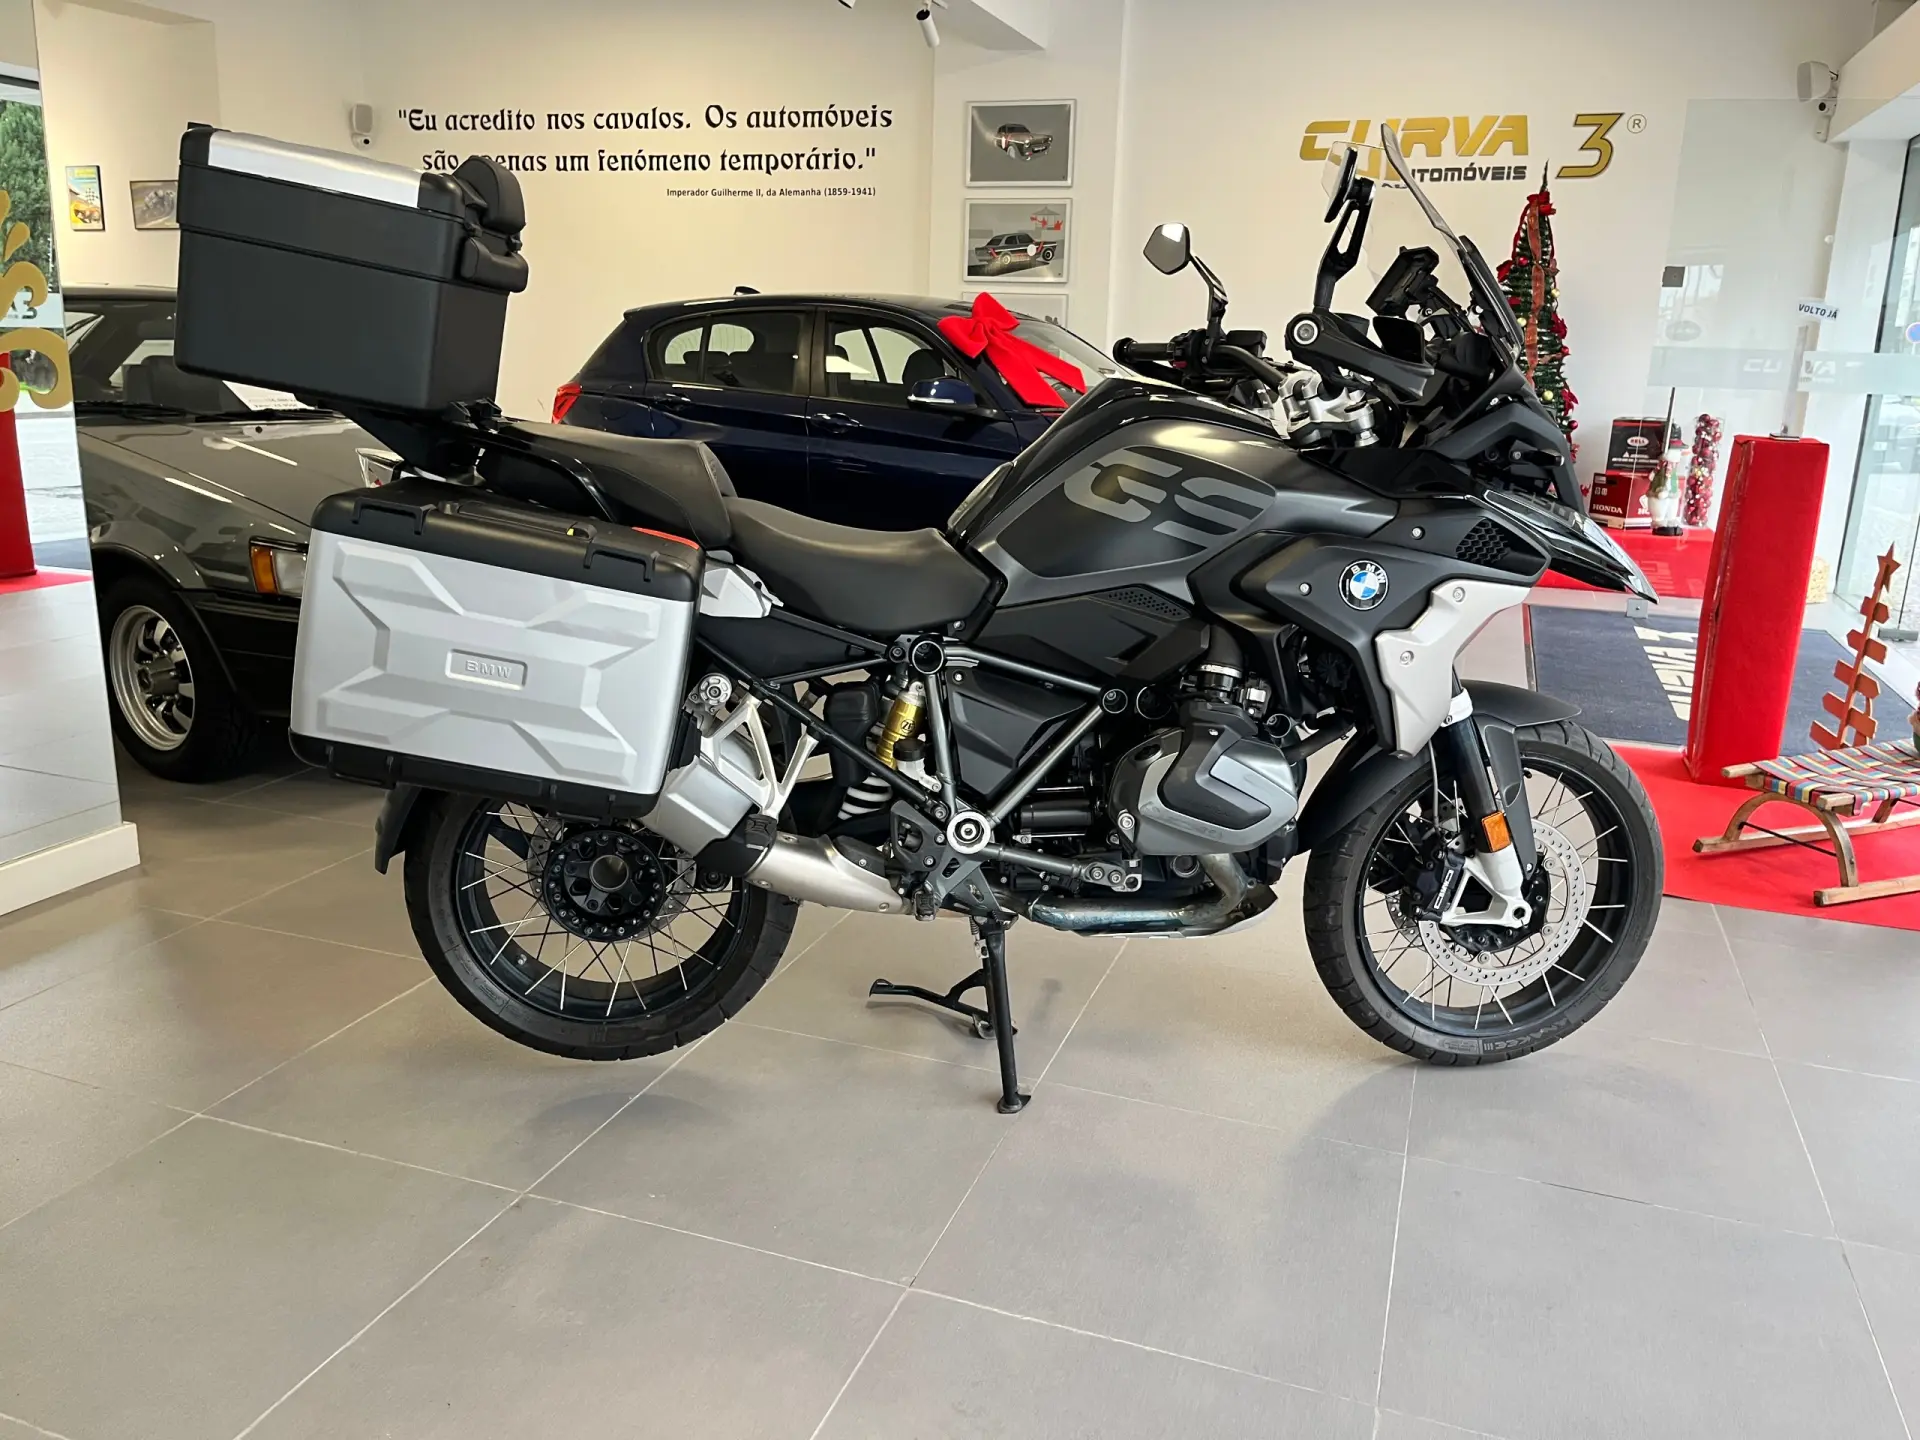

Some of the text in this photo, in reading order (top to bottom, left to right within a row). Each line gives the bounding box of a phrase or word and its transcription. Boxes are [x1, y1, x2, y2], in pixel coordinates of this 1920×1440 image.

[398, 104, 893, 131] "Eu acredito nos cavalos. Os automóveis
[1300, 115, 1529, 161] CURVA
[1556, 112, 1624, 179] 3
[422, 146, 876, 176] são enas um fenómeno temporário."
[666, 186, 876, 199] Imperador Guilherme II, da Alemanha (1859-1941)
[1798, 303, 1838, 319] VOLTO JÁ
[1592, 503, 1623, 514] HONDA
[1350, 563, 1387, 584] BMW
[465, 659, 512, 679] BMW
